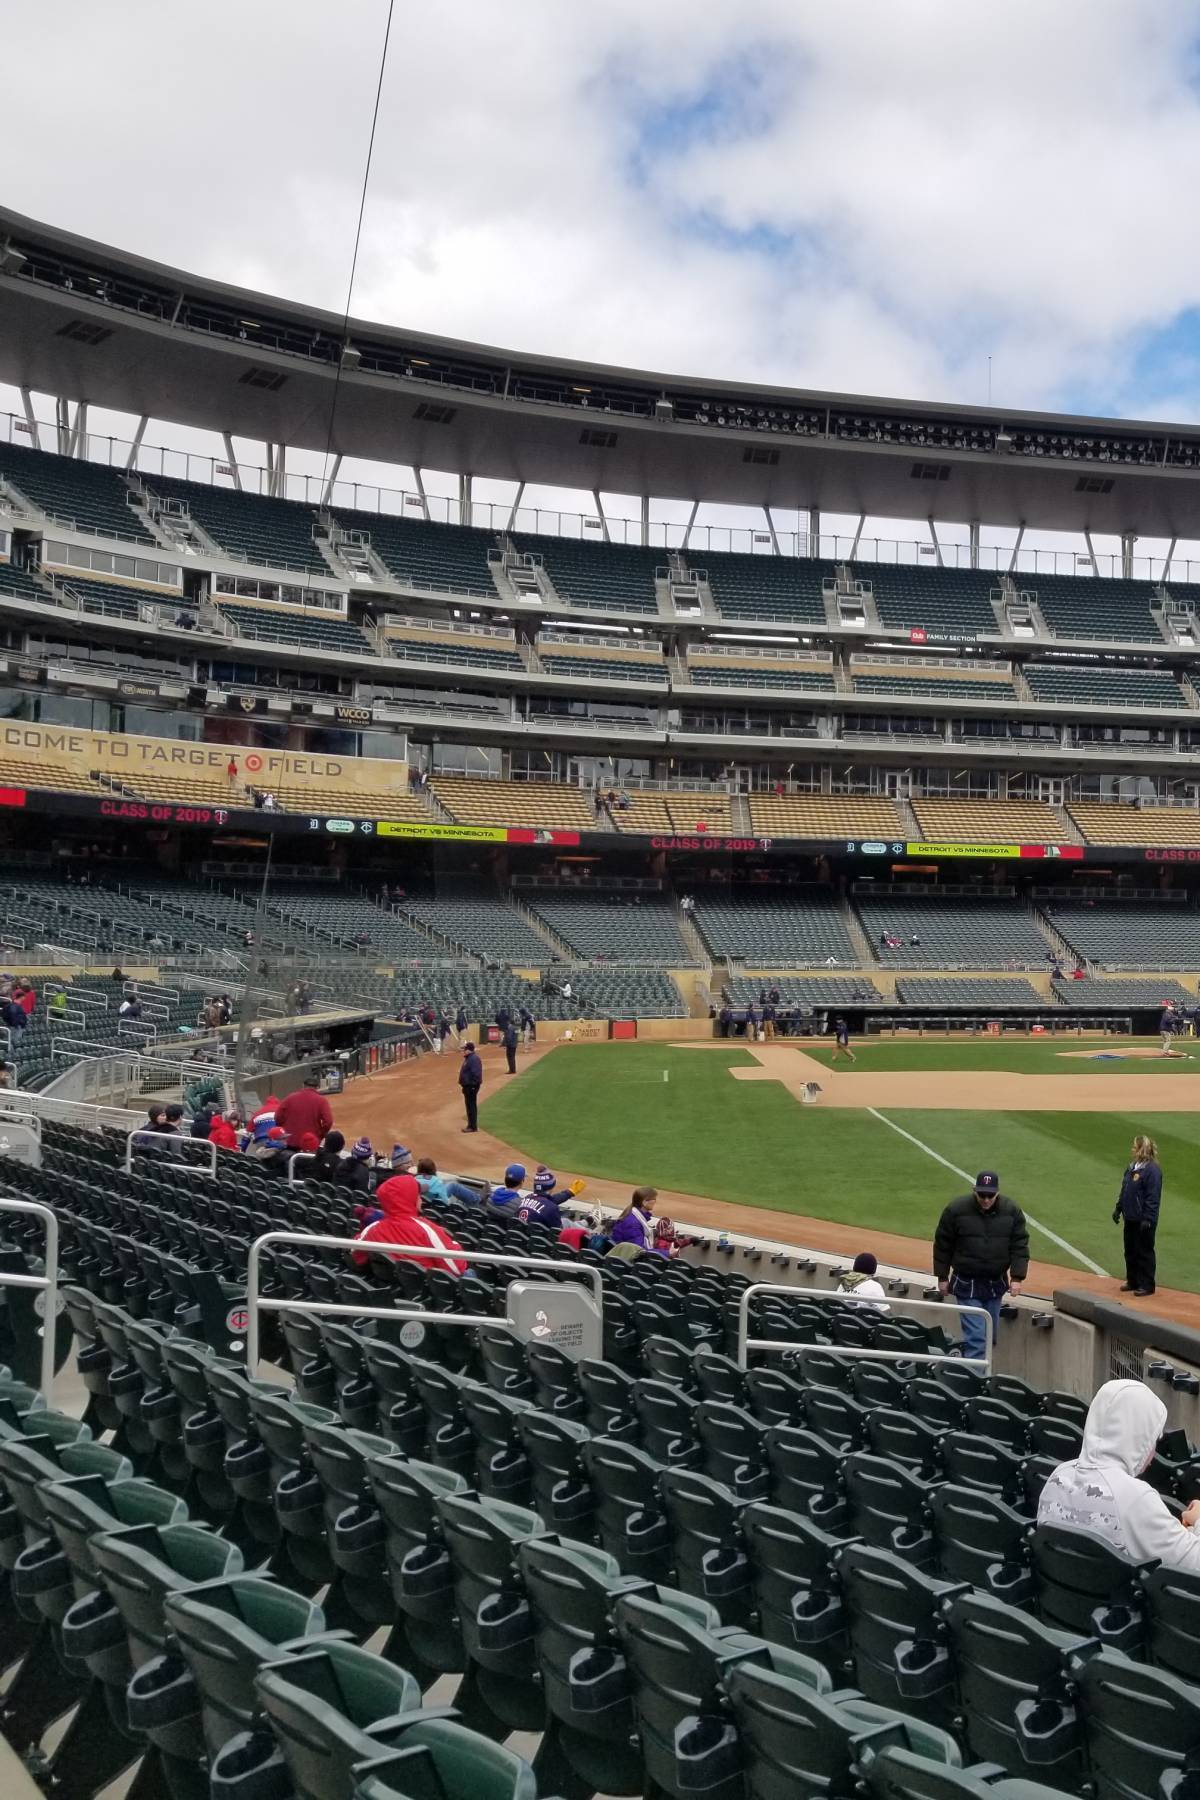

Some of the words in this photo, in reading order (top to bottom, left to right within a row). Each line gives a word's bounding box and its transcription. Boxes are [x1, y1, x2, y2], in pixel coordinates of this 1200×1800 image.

[337, 708, 370, 720] WCCO
[92, 738, 129, 757] TO
[136, 743, 240, 767] TARGET
[268, 757, 343, 777] FIELD
[99, 801, 148, 819] CLASS
[151, 806, 173, 820] OF
[175, 808, 211, 823] 2019
[390, 826, 428, 835] DETROIT
[443, 829, 495, 838] MINNESOTA
[650, 837, 700, 849] CLASS
[703, 838, 721, 849] OF
[725, 838, 756, 850] 2019
[1144, 850, 1185, 861] CLASS
